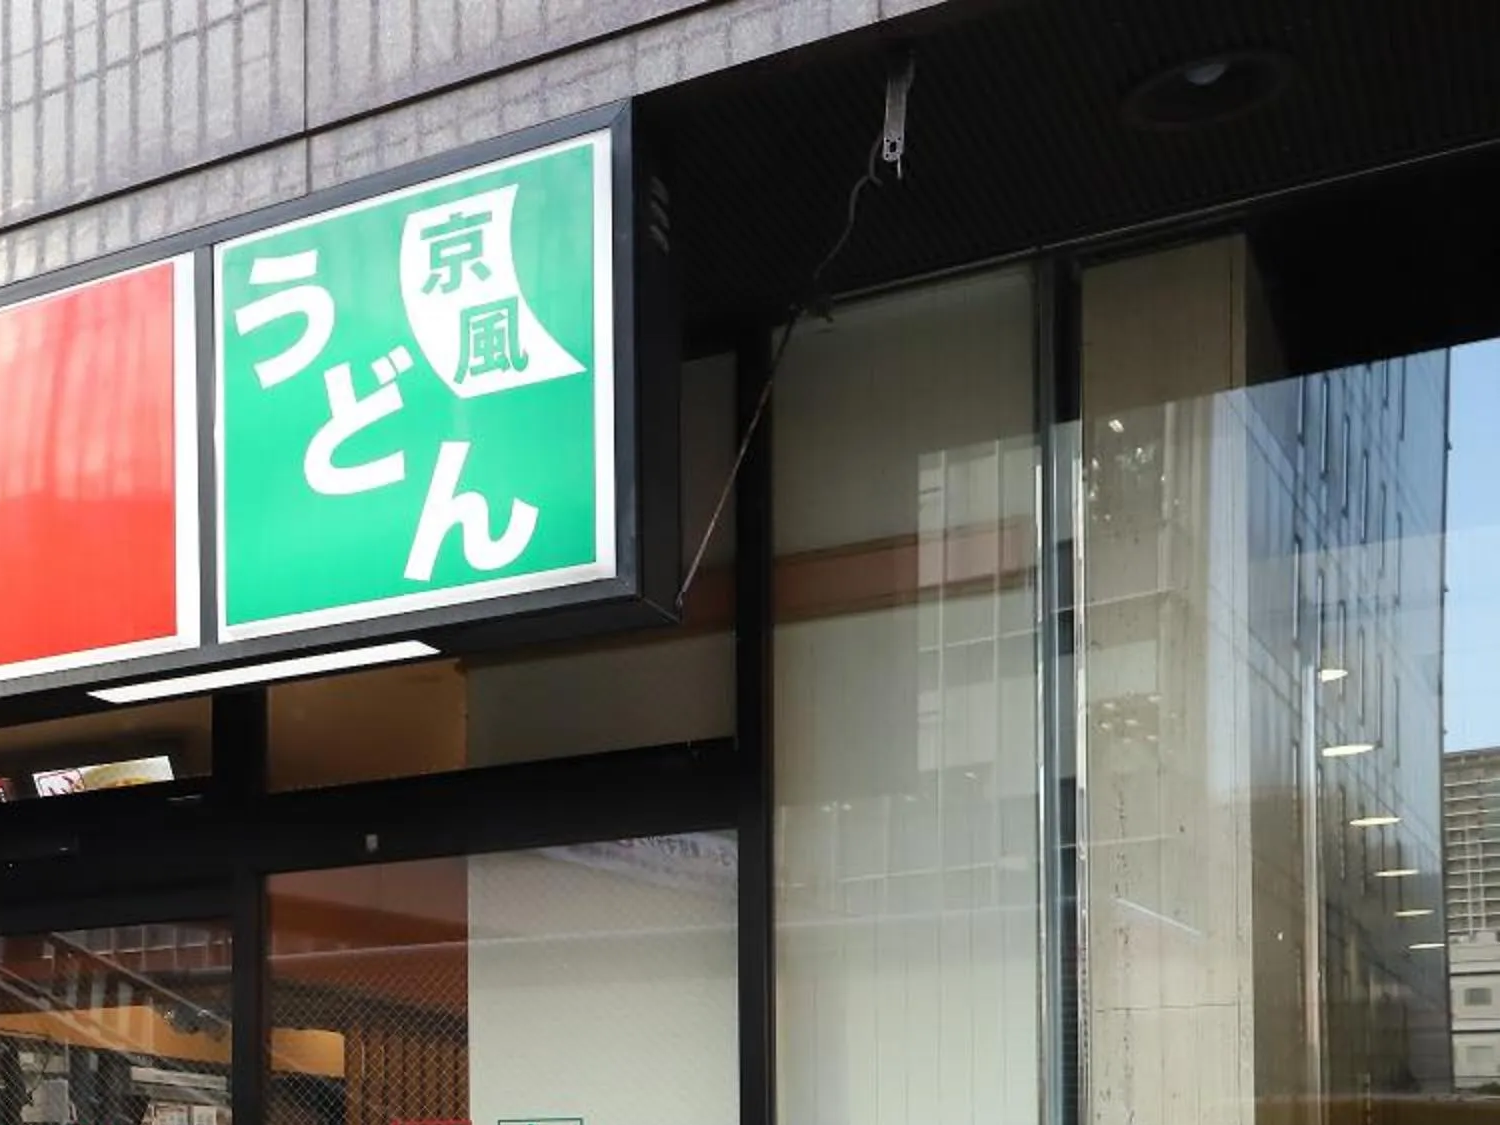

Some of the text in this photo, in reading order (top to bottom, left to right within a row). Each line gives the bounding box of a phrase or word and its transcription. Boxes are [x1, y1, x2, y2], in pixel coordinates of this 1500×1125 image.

[235, 250, 540, 582] うどん
[419, 212, 529, 385] 京風
